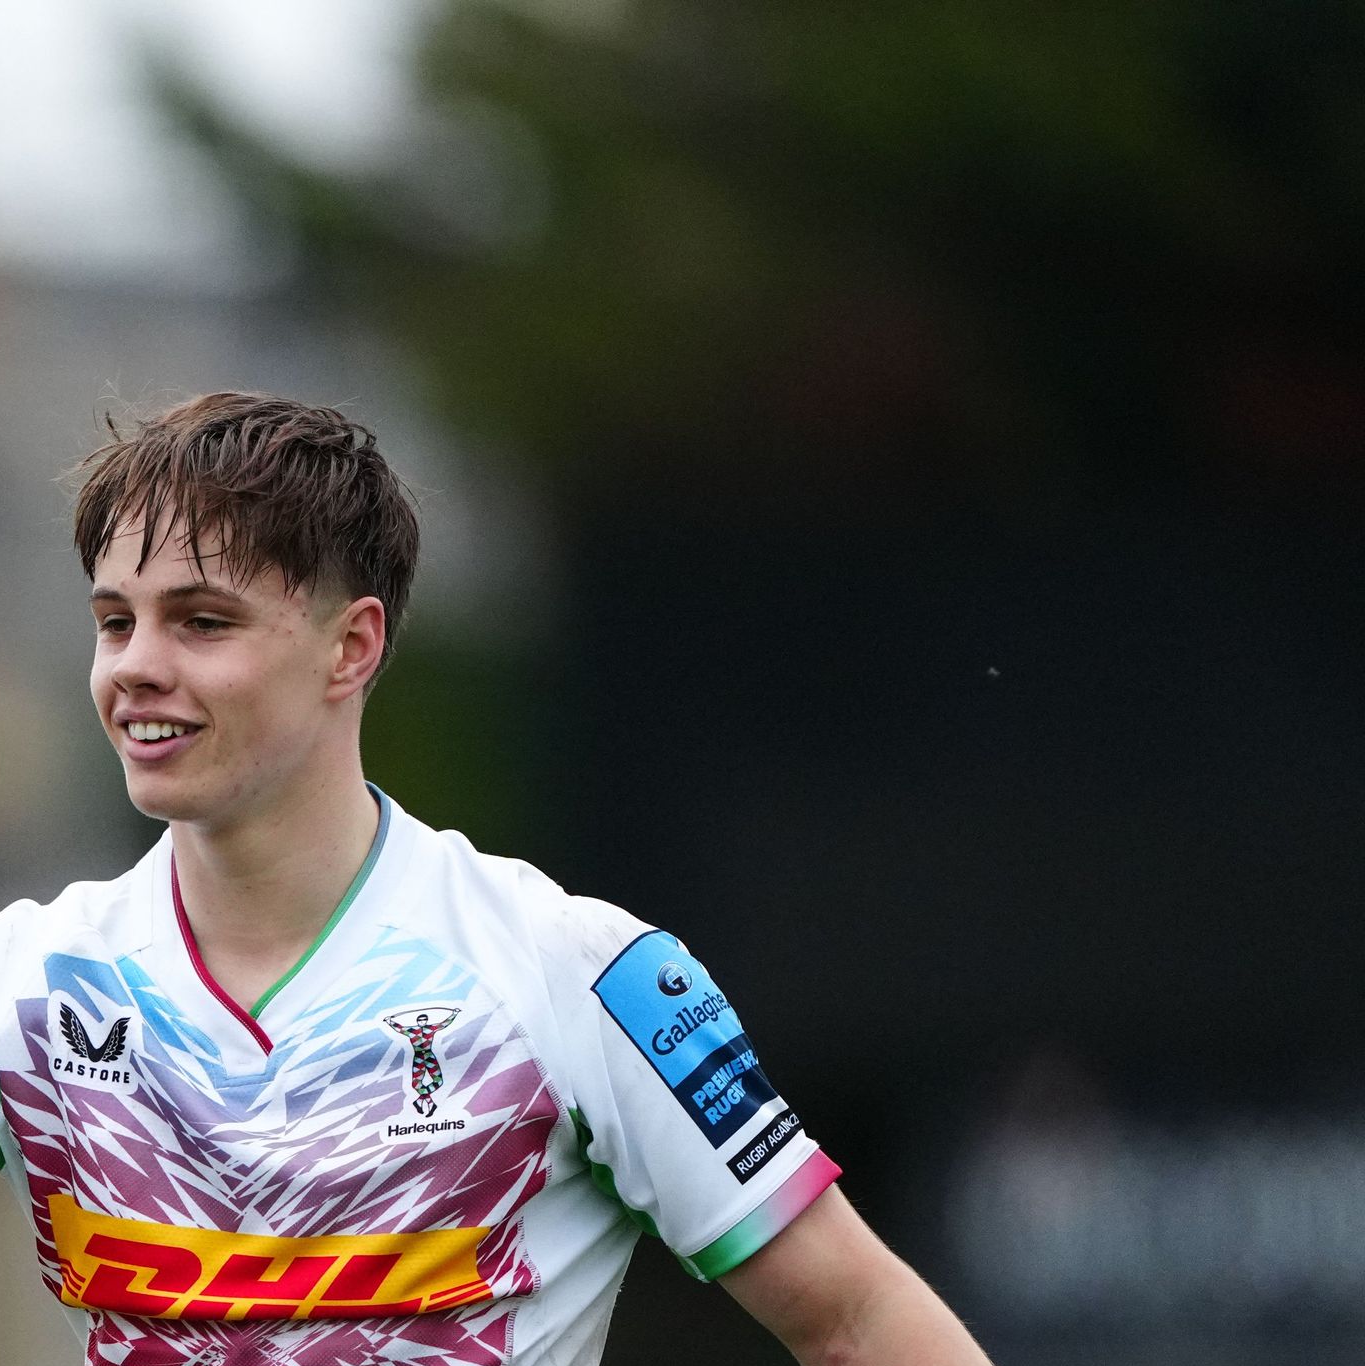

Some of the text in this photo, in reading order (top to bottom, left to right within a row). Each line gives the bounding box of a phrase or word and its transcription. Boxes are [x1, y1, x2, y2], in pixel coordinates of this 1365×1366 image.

[53, 1058, 130, 1084] CASTORE
[387, 1119, 466, 1137] Harlequins
[736, 1140, 769, 1174] RUGBY
[80, 1233, 422, 1321] DHL
